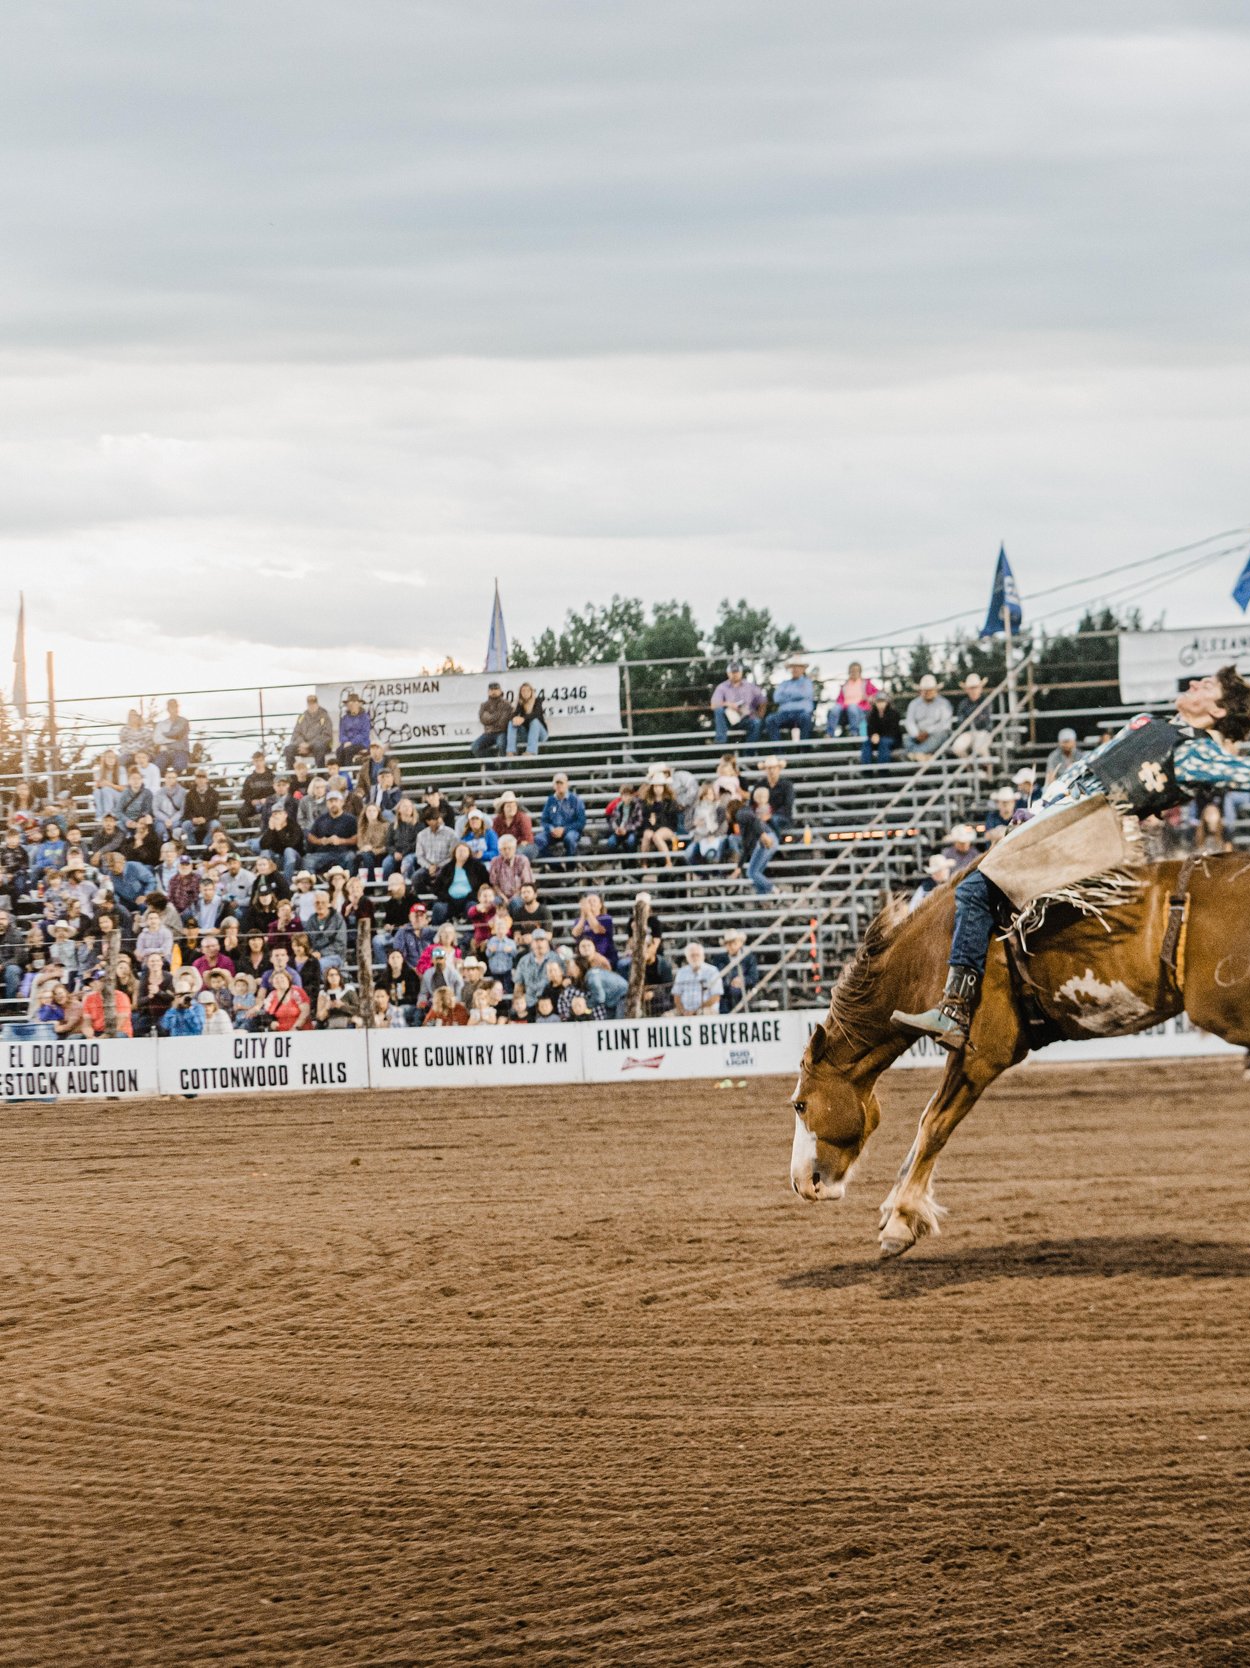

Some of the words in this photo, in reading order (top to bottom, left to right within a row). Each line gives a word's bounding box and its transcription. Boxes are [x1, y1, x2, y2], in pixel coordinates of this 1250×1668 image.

[567, 704, 587, 715] USA
[234, 1037, 268, 1060] CITY
[274, 1036, 292, 1058] OF
[597, 1028, 640, 1051] FLINT
[649, 1025, 692, 1048] HILLS
[700, 1020, 781, 1045] BEVERAGE
[9, 1045, 24, 1068] EL
[32, 1043, 100, 1067] DORADO
[382, 1047, 418, 1067] KVOE
[424, 1045, 494, 1066] COUNTRY
[501, 1043, 539, 1065] 101.7
[546, 1042, 567, 1063] FM
[67, 1069, 139, 1094] AUCTION
[180, 1065, 289, 1090] COTTONWOOD
[302, 1062, 347, 1085] FALLS
